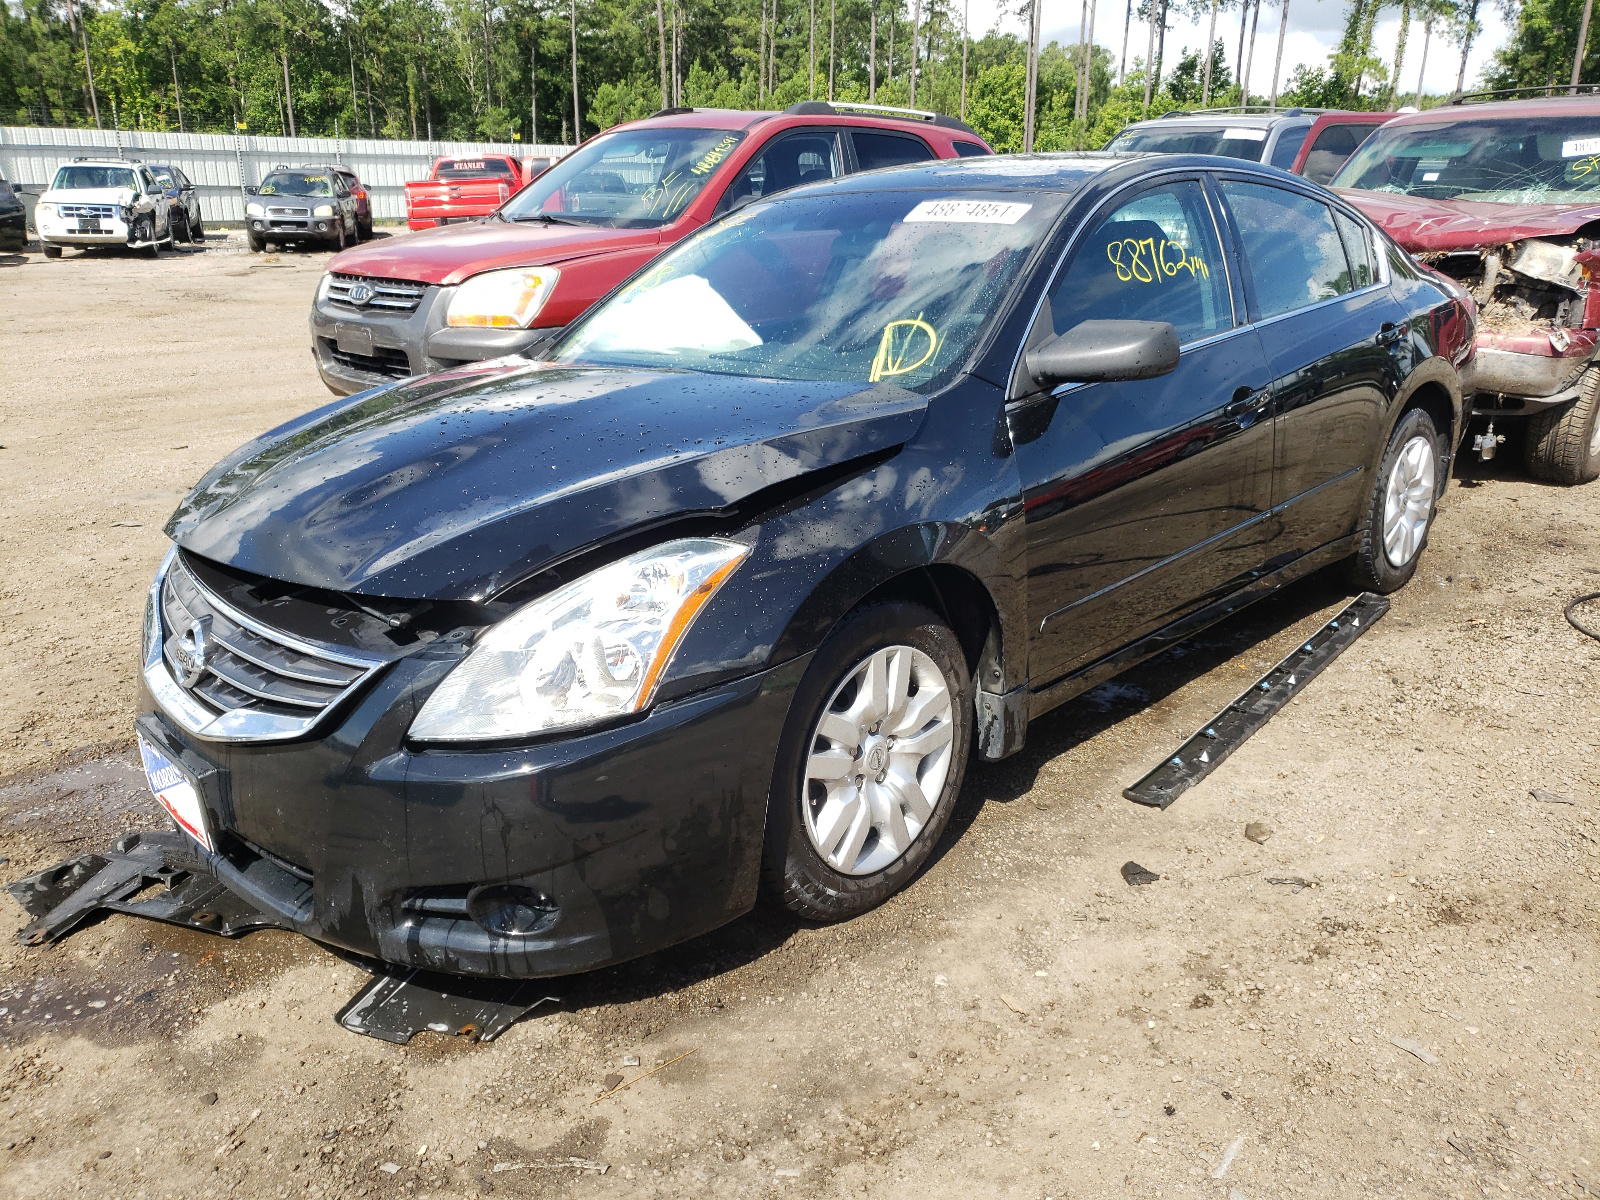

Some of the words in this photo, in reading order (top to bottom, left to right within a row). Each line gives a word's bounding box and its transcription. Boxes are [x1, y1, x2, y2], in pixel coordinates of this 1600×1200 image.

[453, 161, 485, 170] STANLEY
[924, 202, 1013, 218] 4884851
[351, 287, 368, 300] KIA
